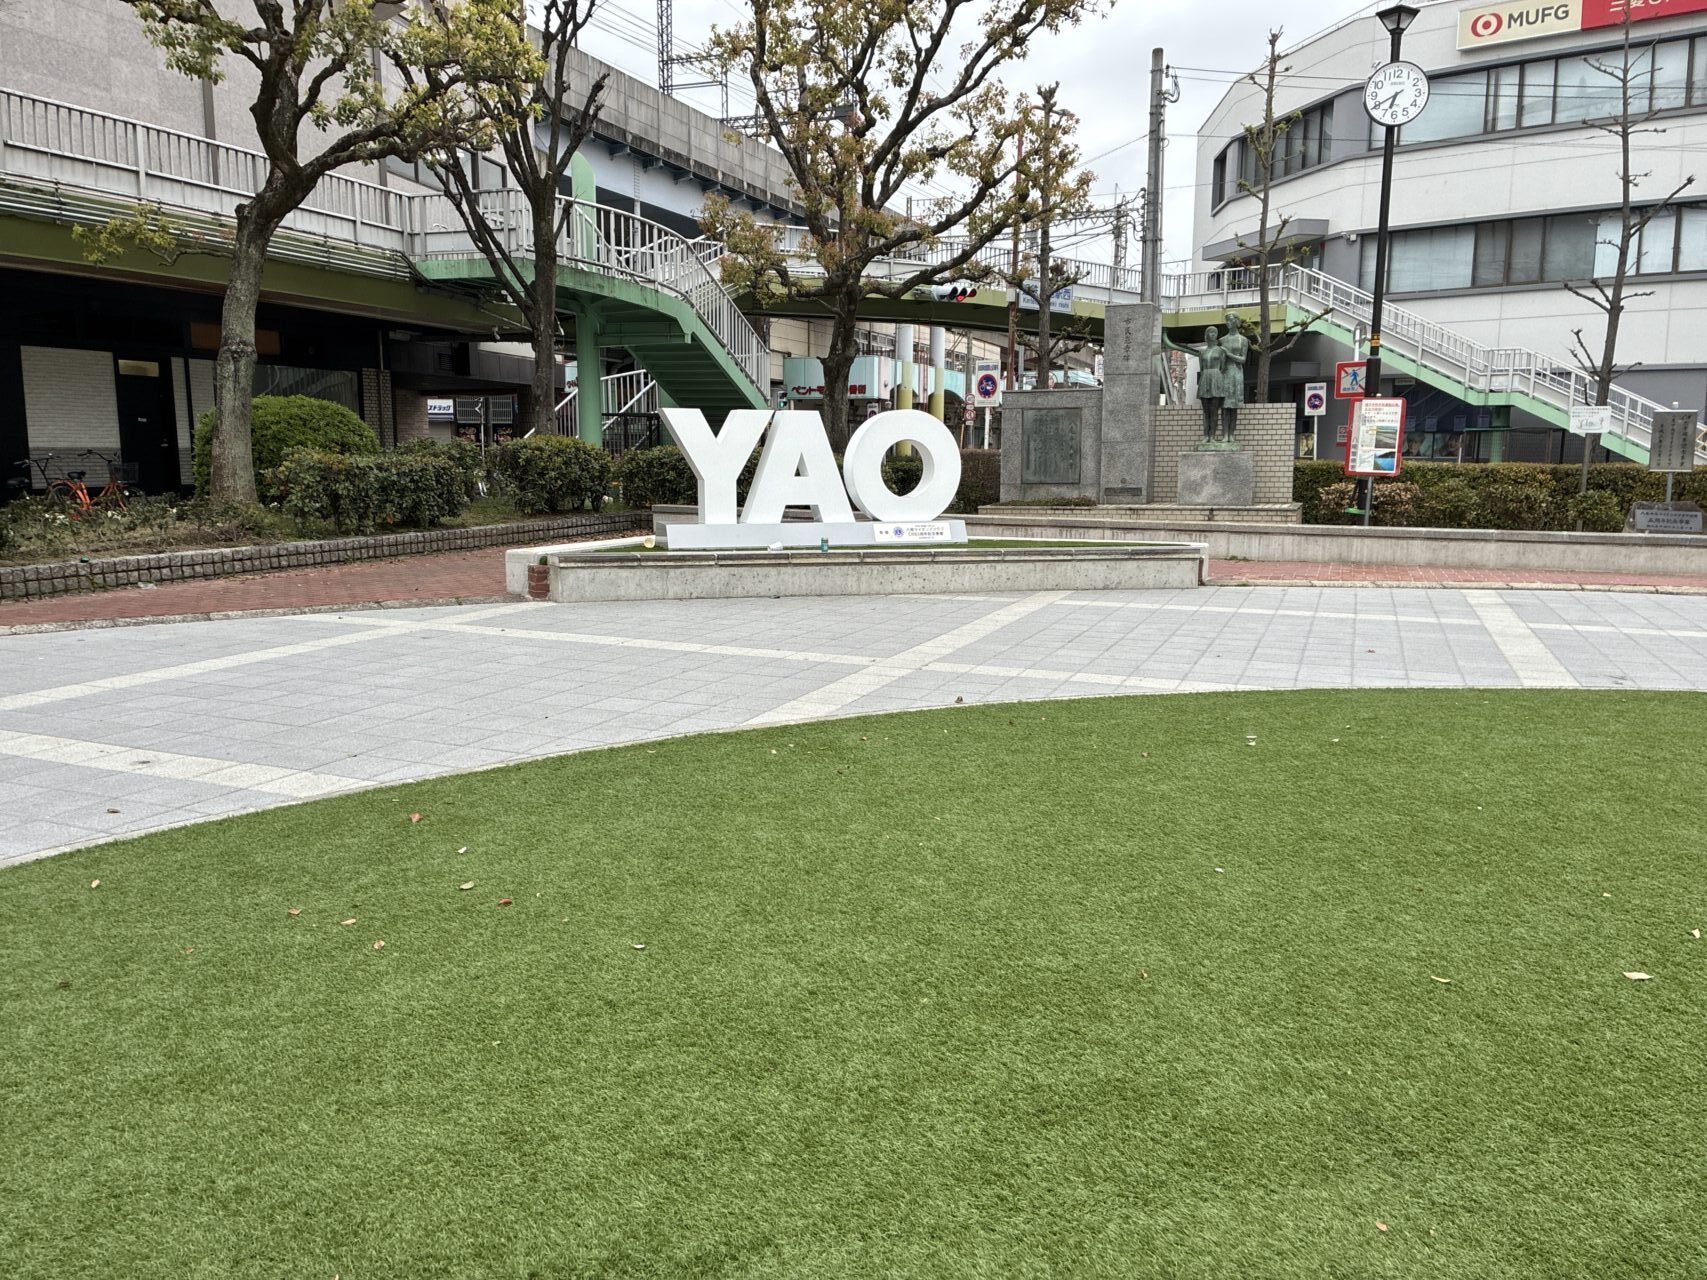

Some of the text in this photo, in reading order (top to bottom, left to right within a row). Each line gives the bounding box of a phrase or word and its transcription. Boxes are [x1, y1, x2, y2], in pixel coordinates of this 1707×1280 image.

[1507, 4, 1569, 29] MUFG
[1393, 69, 1403, 78] 12
[1374, 80, 1384, 90] 10
[1412, 77, 1420, 87] 2
[1370, 91, 1378, 101] 9
[1414, 88, 1422, 98] 3
[1410, 99, 1418, 108] 4
[1382, 108, 1389, 118] 7
[1390, 110, 1398, 120] 6
[1401, 107, 1409, 117] 5
[658, 408, 962, 524] YAO
